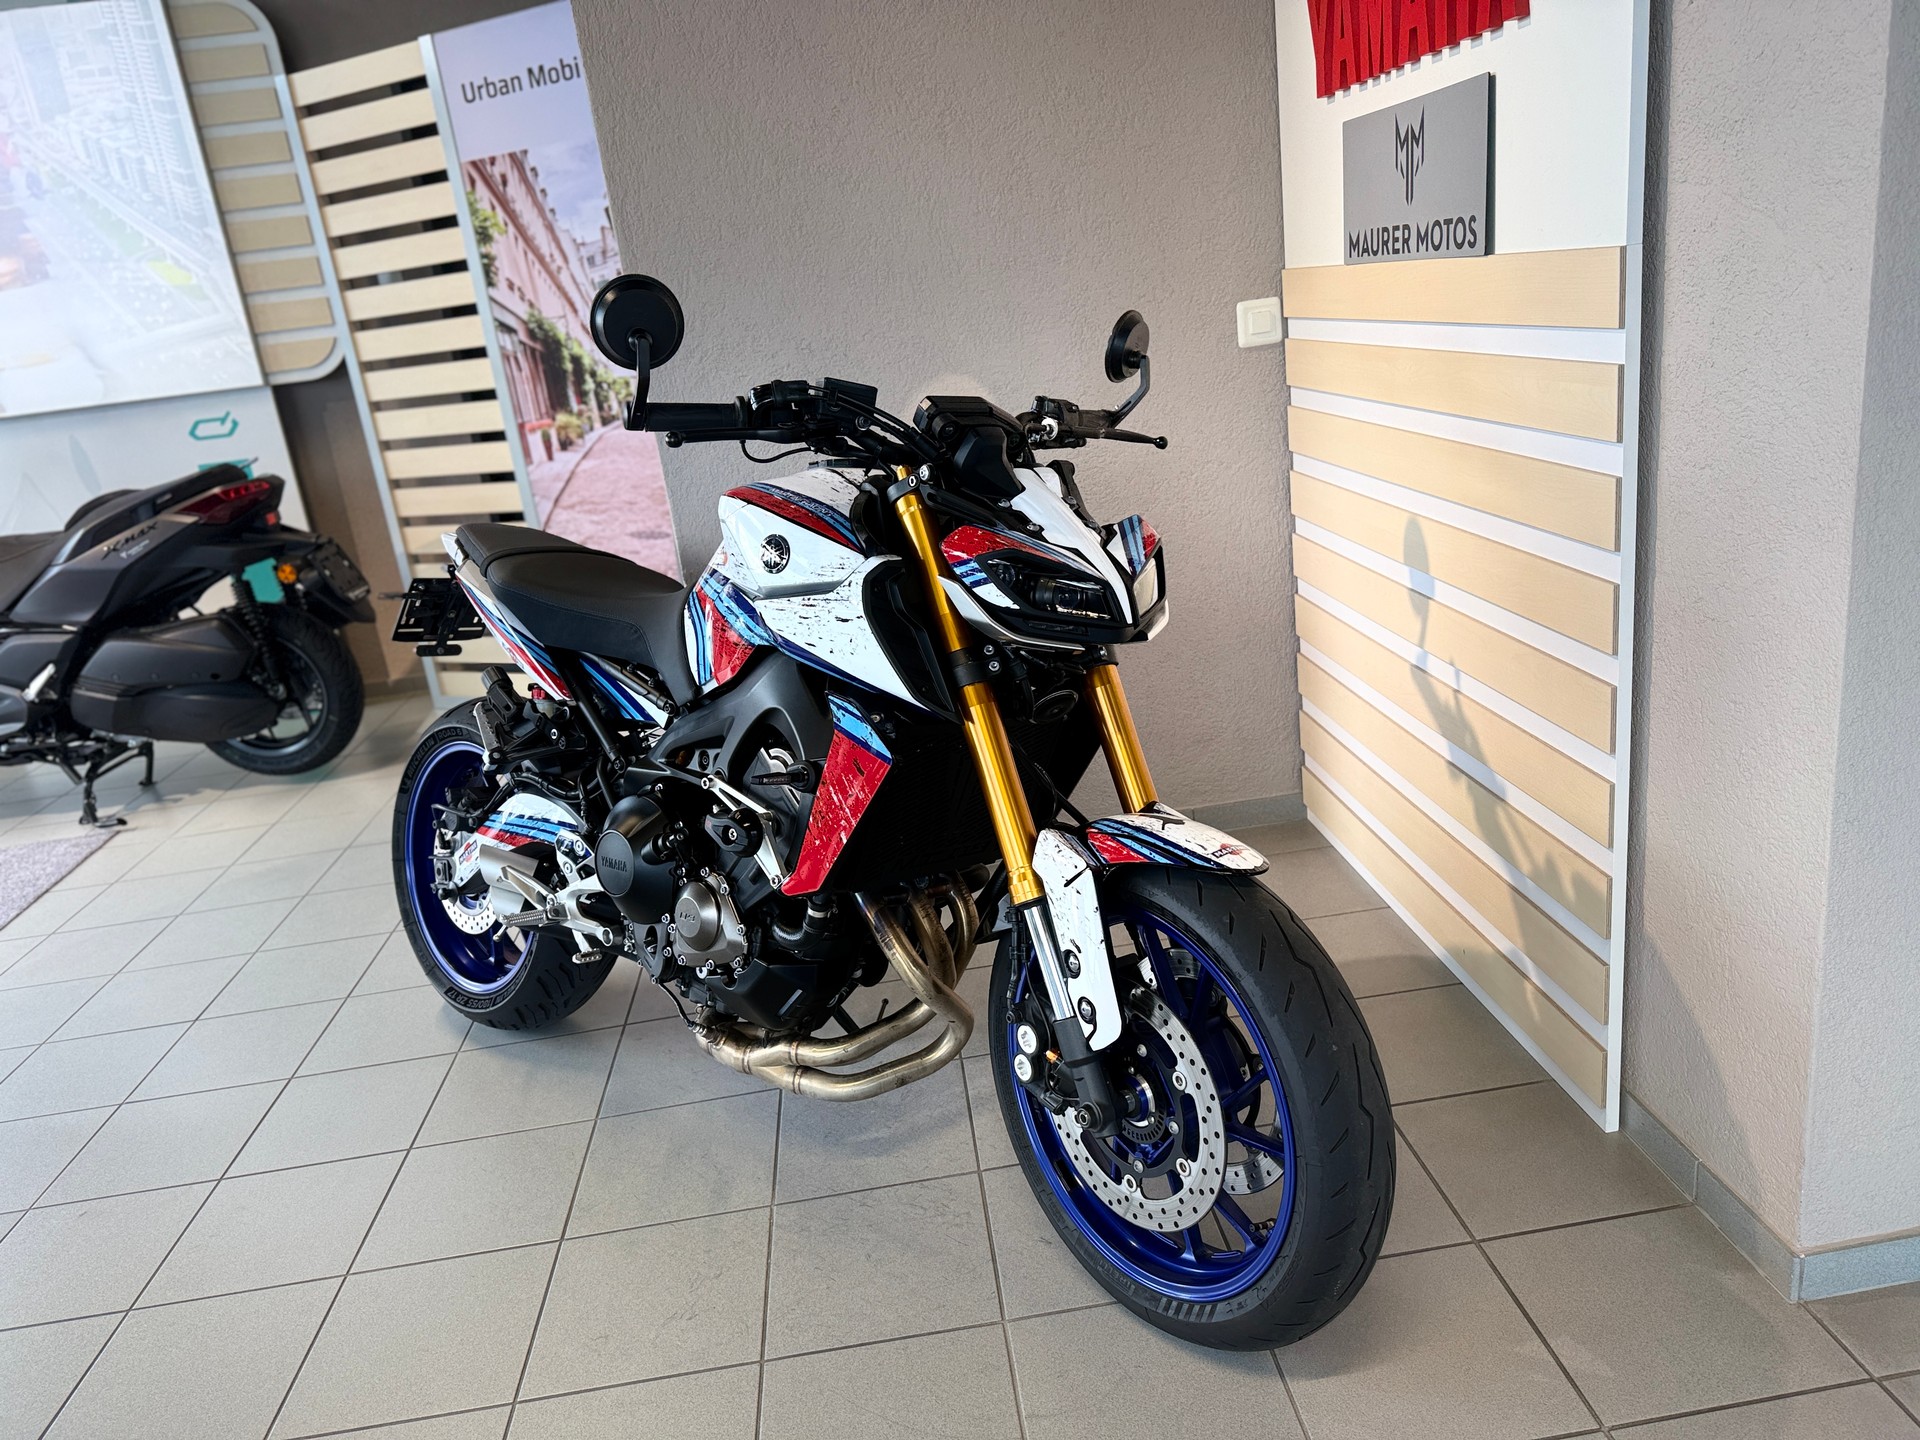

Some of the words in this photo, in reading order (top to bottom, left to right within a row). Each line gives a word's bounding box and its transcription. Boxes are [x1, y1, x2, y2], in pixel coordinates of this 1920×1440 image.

[461, 76, 524, 104] Urban
[526, 56, 581, 89] Mobi
[1348, 223, 1412, 258] MAURER
[1416, 214, 1478, 253] MOTOS
[408, 736, 436, 779] MICHELIN
[601, 855, 628, 873] YAMAHA
